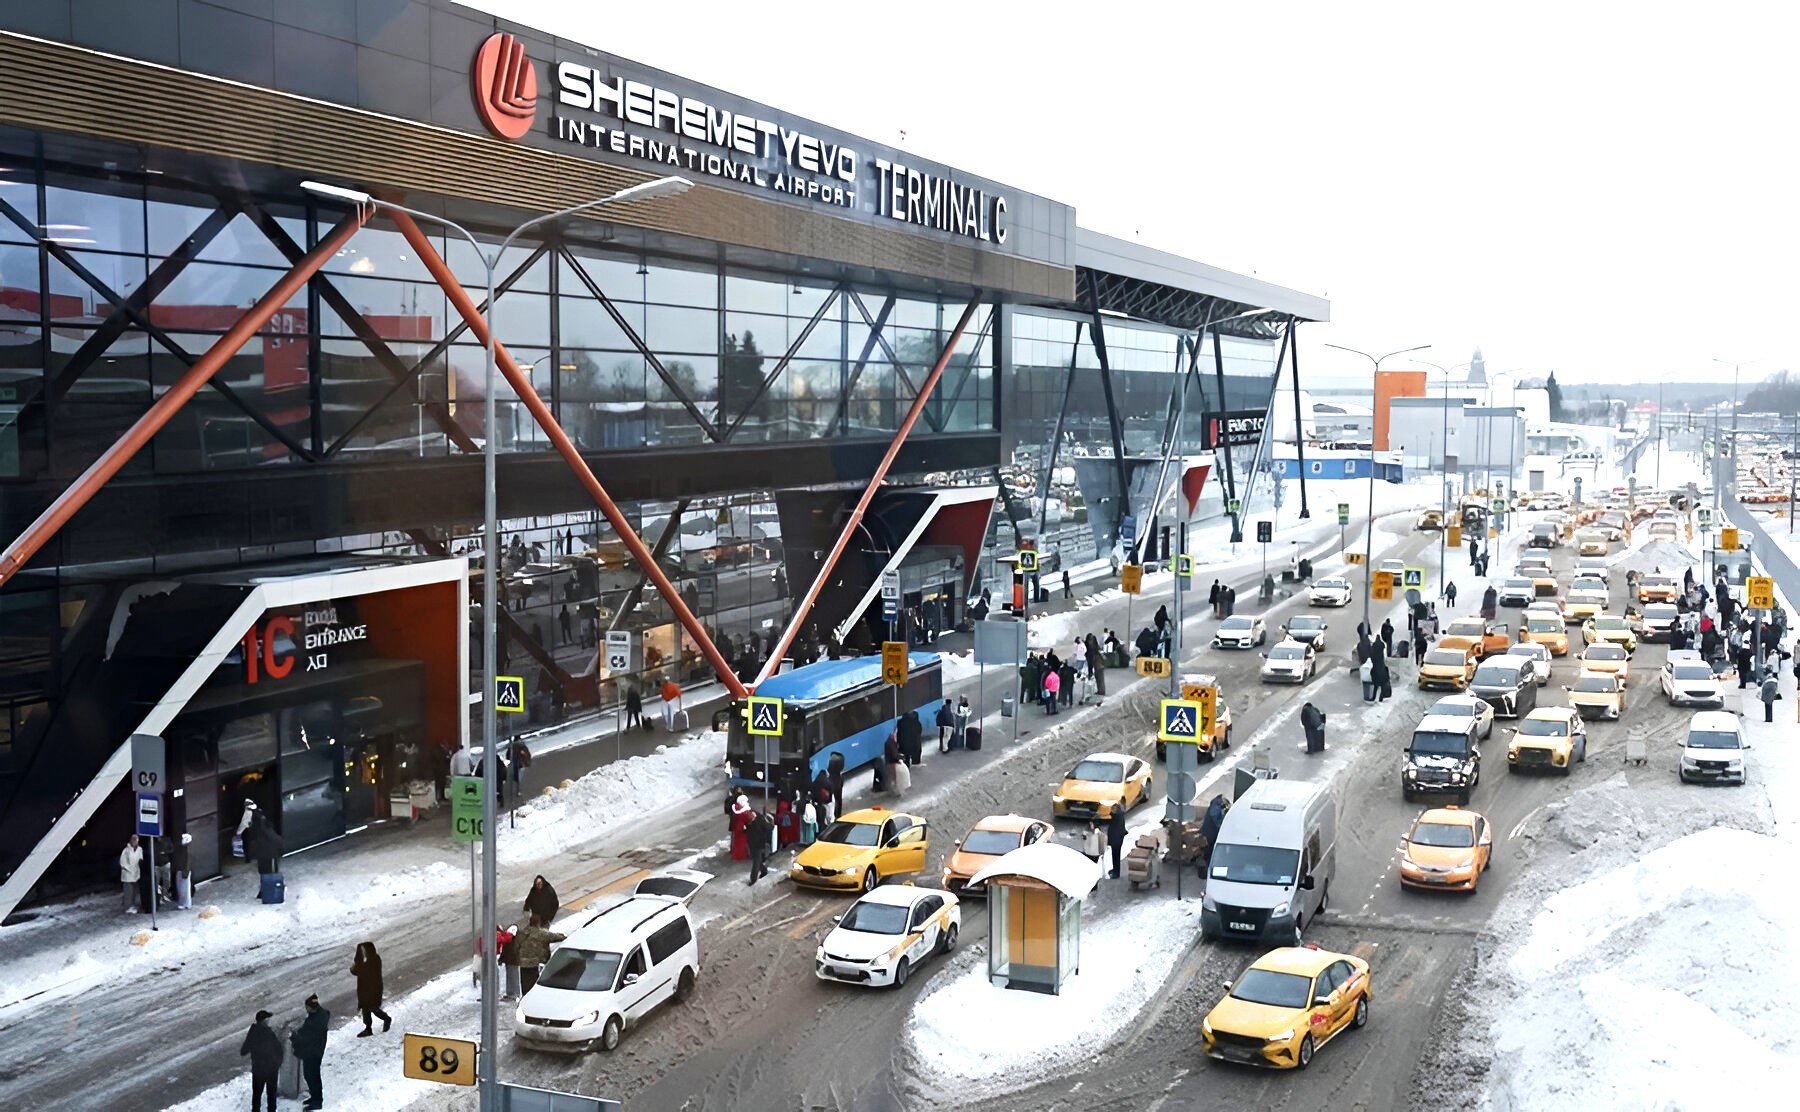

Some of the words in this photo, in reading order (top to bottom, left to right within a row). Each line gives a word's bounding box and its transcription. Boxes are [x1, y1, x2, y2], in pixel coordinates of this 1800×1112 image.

[558, 61, 856, 183] SHEREMETYEVO
[558, 116, 767, 187] INTERNATIONAL
[774, 172, 856, 208] AIRPORT
[876, 158, 990, 241] TERMINAL
[995, 195, 1007, 244] C
[419, 1045, 459, 1075] 89
